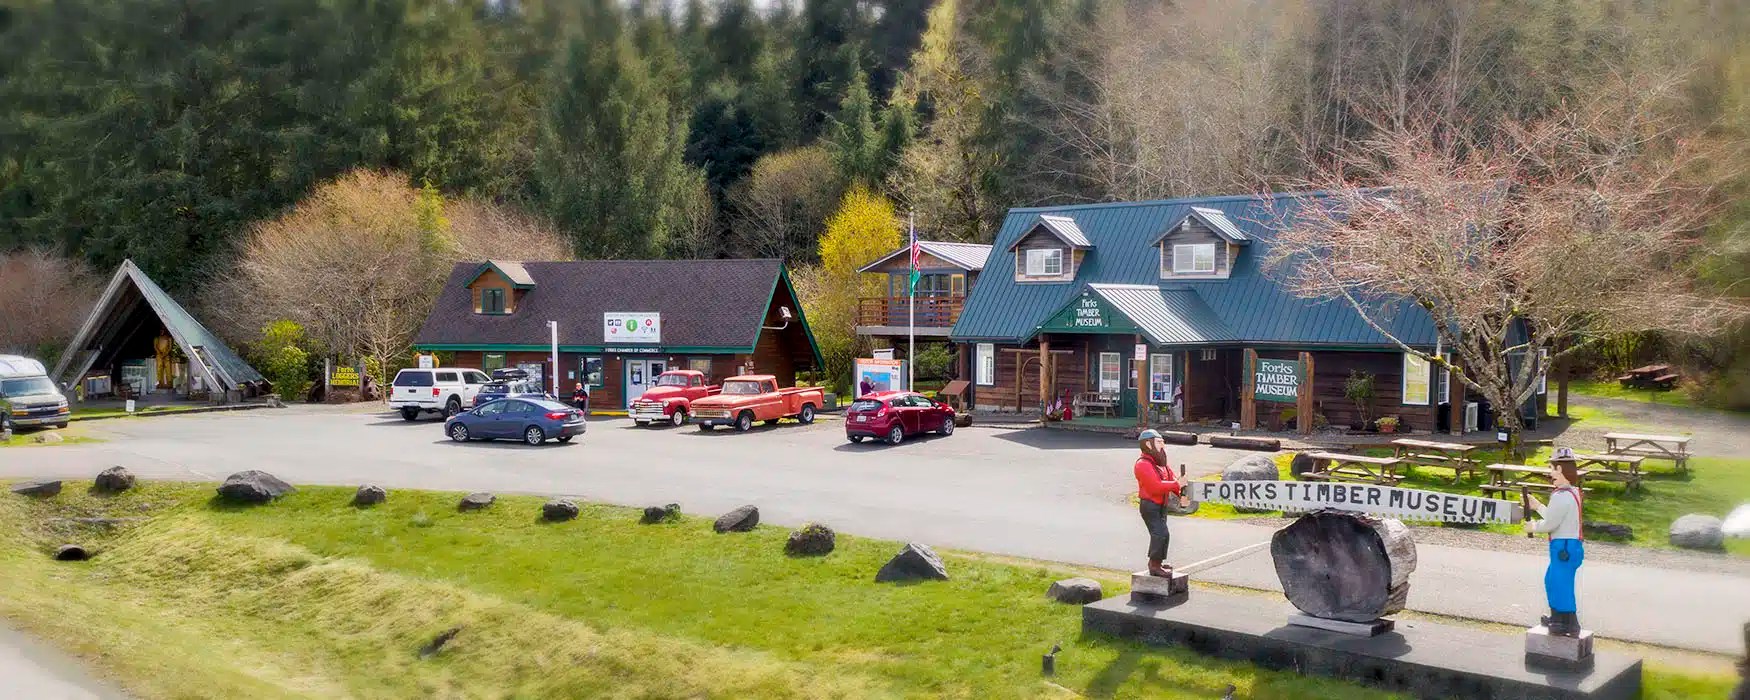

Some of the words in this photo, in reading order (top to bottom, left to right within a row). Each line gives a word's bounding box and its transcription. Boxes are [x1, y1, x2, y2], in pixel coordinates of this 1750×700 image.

[1082, 299, 1097, 308] Forks
[1076, 308, 1100, 317] TIMBER
[1075, 318, 1102, 327] MUSEUM
[1261, 361, 1293, 374] Forks
[1255, 372, 1299, 386] TIMBER
[1255, 383, 1298, 397] MUSEUM
[1203, 483, 1278, 500] FORKS
[1285, 483, 1381, 506] TIMBER
[1389, 489, 1497, 521] MUSEUM
